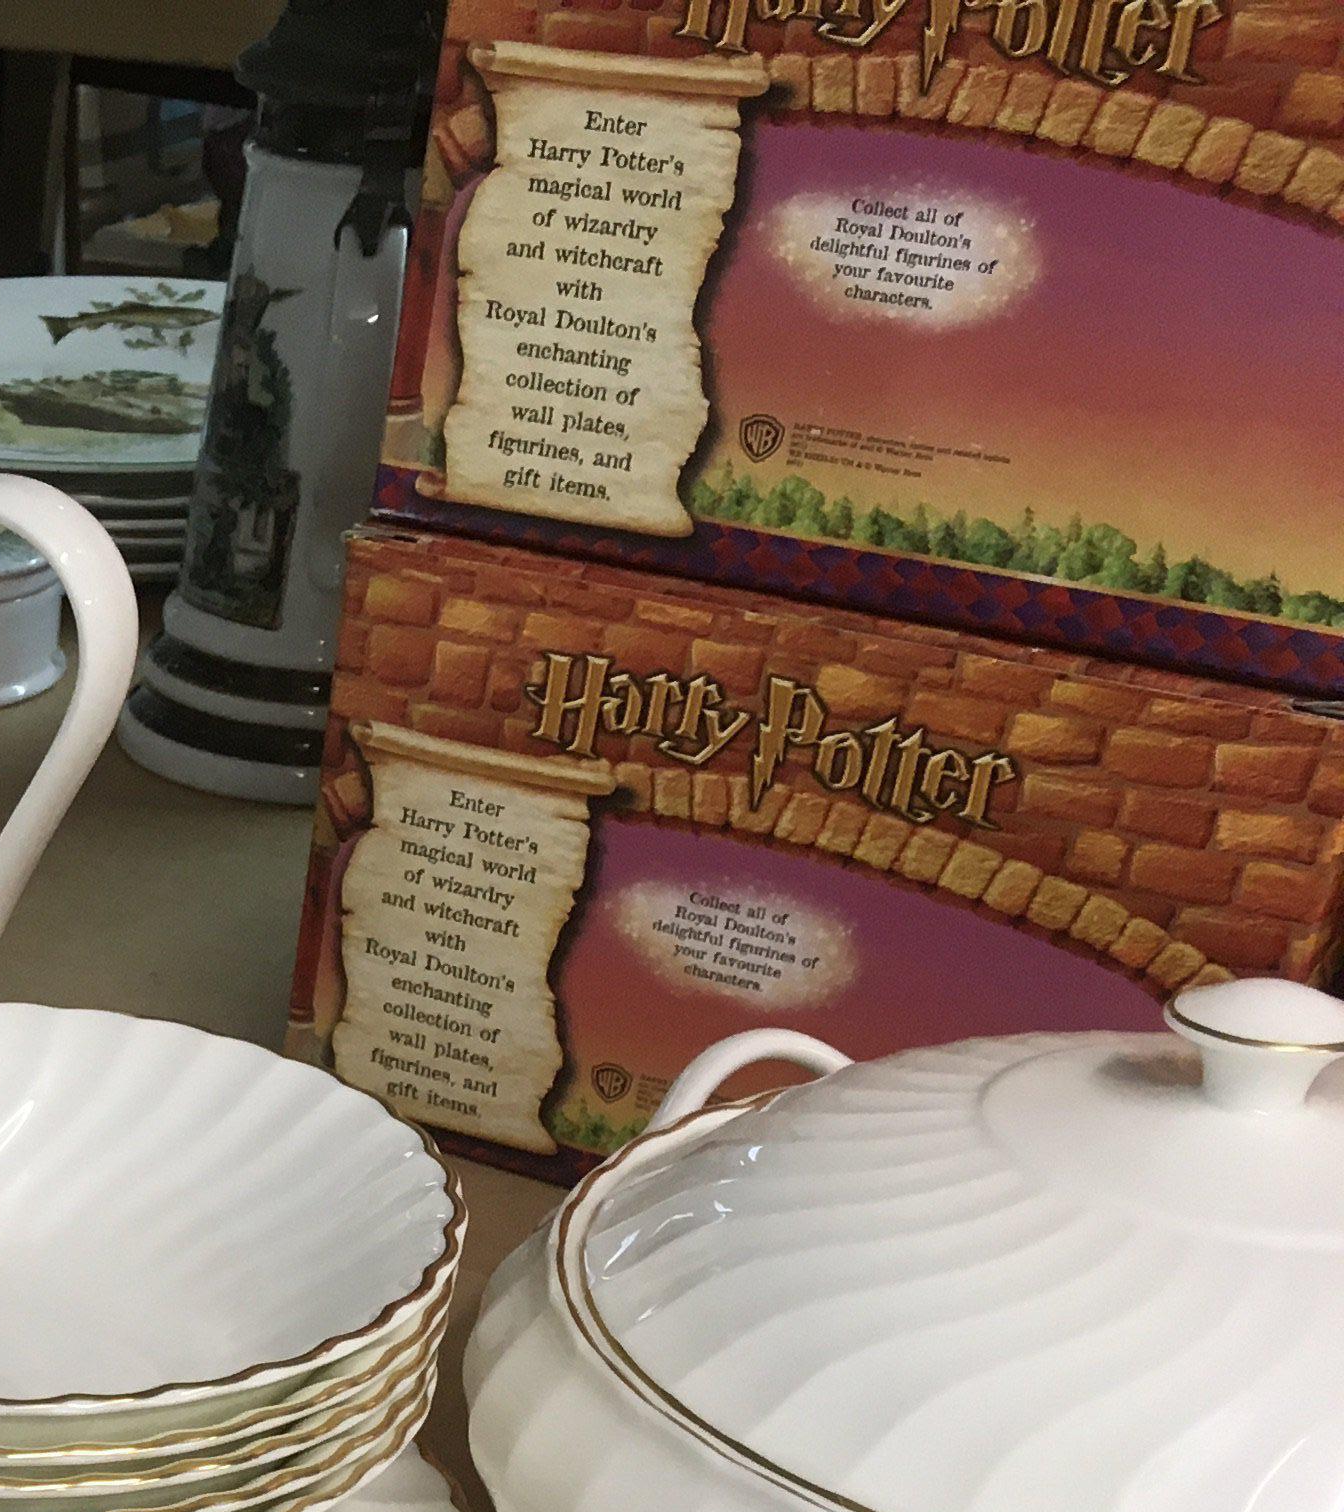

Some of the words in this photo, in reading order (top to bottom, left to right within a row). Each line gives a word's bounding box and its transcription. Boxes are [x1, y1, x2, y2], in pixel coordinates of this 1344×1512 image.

[584, 110, 648, 136] Enter
[527, 137, 592, 169] Harry
[600, 145, 685, 176] Potter's
[528, 177, 612, 201] magical
[622, 189, 682, 211] world
[851, 198, 909, 220] Collect
[914, 208, 937, 224] all
[943, 212, 964, 227] of
[532, 209, 557, 228] of
[564, 213, 659, 246] wizardry
[834, 217, 883, 239] Royal
[889, 225, 972, 250] Doulton's
[506, 241, 545, 260] and
[555, 246, 663, 277] witchcraft
[810, 236, 889, 261] delightful
[894, 248, 972, 272] figurines
[977, 259, 1000, 275] of
[556, 279, 602, 301] with
[832, 263, 872, 279] your
[876, 266, 955, 291] favourite
[844, 284, 933, 310] characters.
[485, 299, 546, 329] Royal
[555, 310, 657, 343] Doulton's
[516, 342, 632, 376] enchanting
[505, 372, 607, 402] collection
[616, 387, 641, 406] of
[511, 405, 554, 426] wall
[561, 411, 630, 441] plates,
[488, 430, 584, 466] figurines,
[592, 452, 632, 472] and
[503, 466, 541, 488] gift
[549, 472, 611, 501] items.
[525, 652, 750, 765] Harry
[749, 675, 1016, 830] Potter
[449, 789, 506, 818] Enter
[399, 806, 456, 839] Harry
[463, 821, 538, 855] Potter's
[399, 839, 474, 869] magical
[482, 859, 537, 884] world
[404, 868, 425, 885] of
[432, 876, 515, 910] wizardry
[381, 891, 416, 912] and
[423, 902, 520, 938] witchcraft
[674, 905, 718, 928] Royal
[724, 917, 797, 946] Doulton's
[689, 891, 741, 915] Collect
[747, 906, 767, 920] all
[772, 913, 790, 926] of
[425, 930, 466, 952] with
[652, 919, 724, 947] delightful
[728, 937, 796, 964] figurines
[801, 956, 820, 970] of
[364, 937, 417, 966] Royal
[424, 954, 515, 994] Doulton's
[673, 943, 707, 960] your
[713, 951, 782, 980] favourite
[391, 977, 493, 1018] enchanting
[383, 1002, 472, 1037] collection
[479, 1028, 502, 1044] of
[389, 1029, 426, 1050] wall
[433, 1041, 494, 1072] plates,
[370, 1047, 456, 1088] figurines,
[463, 1077, 498, 1098] and
[386, 1081, 419, 1100] gift
